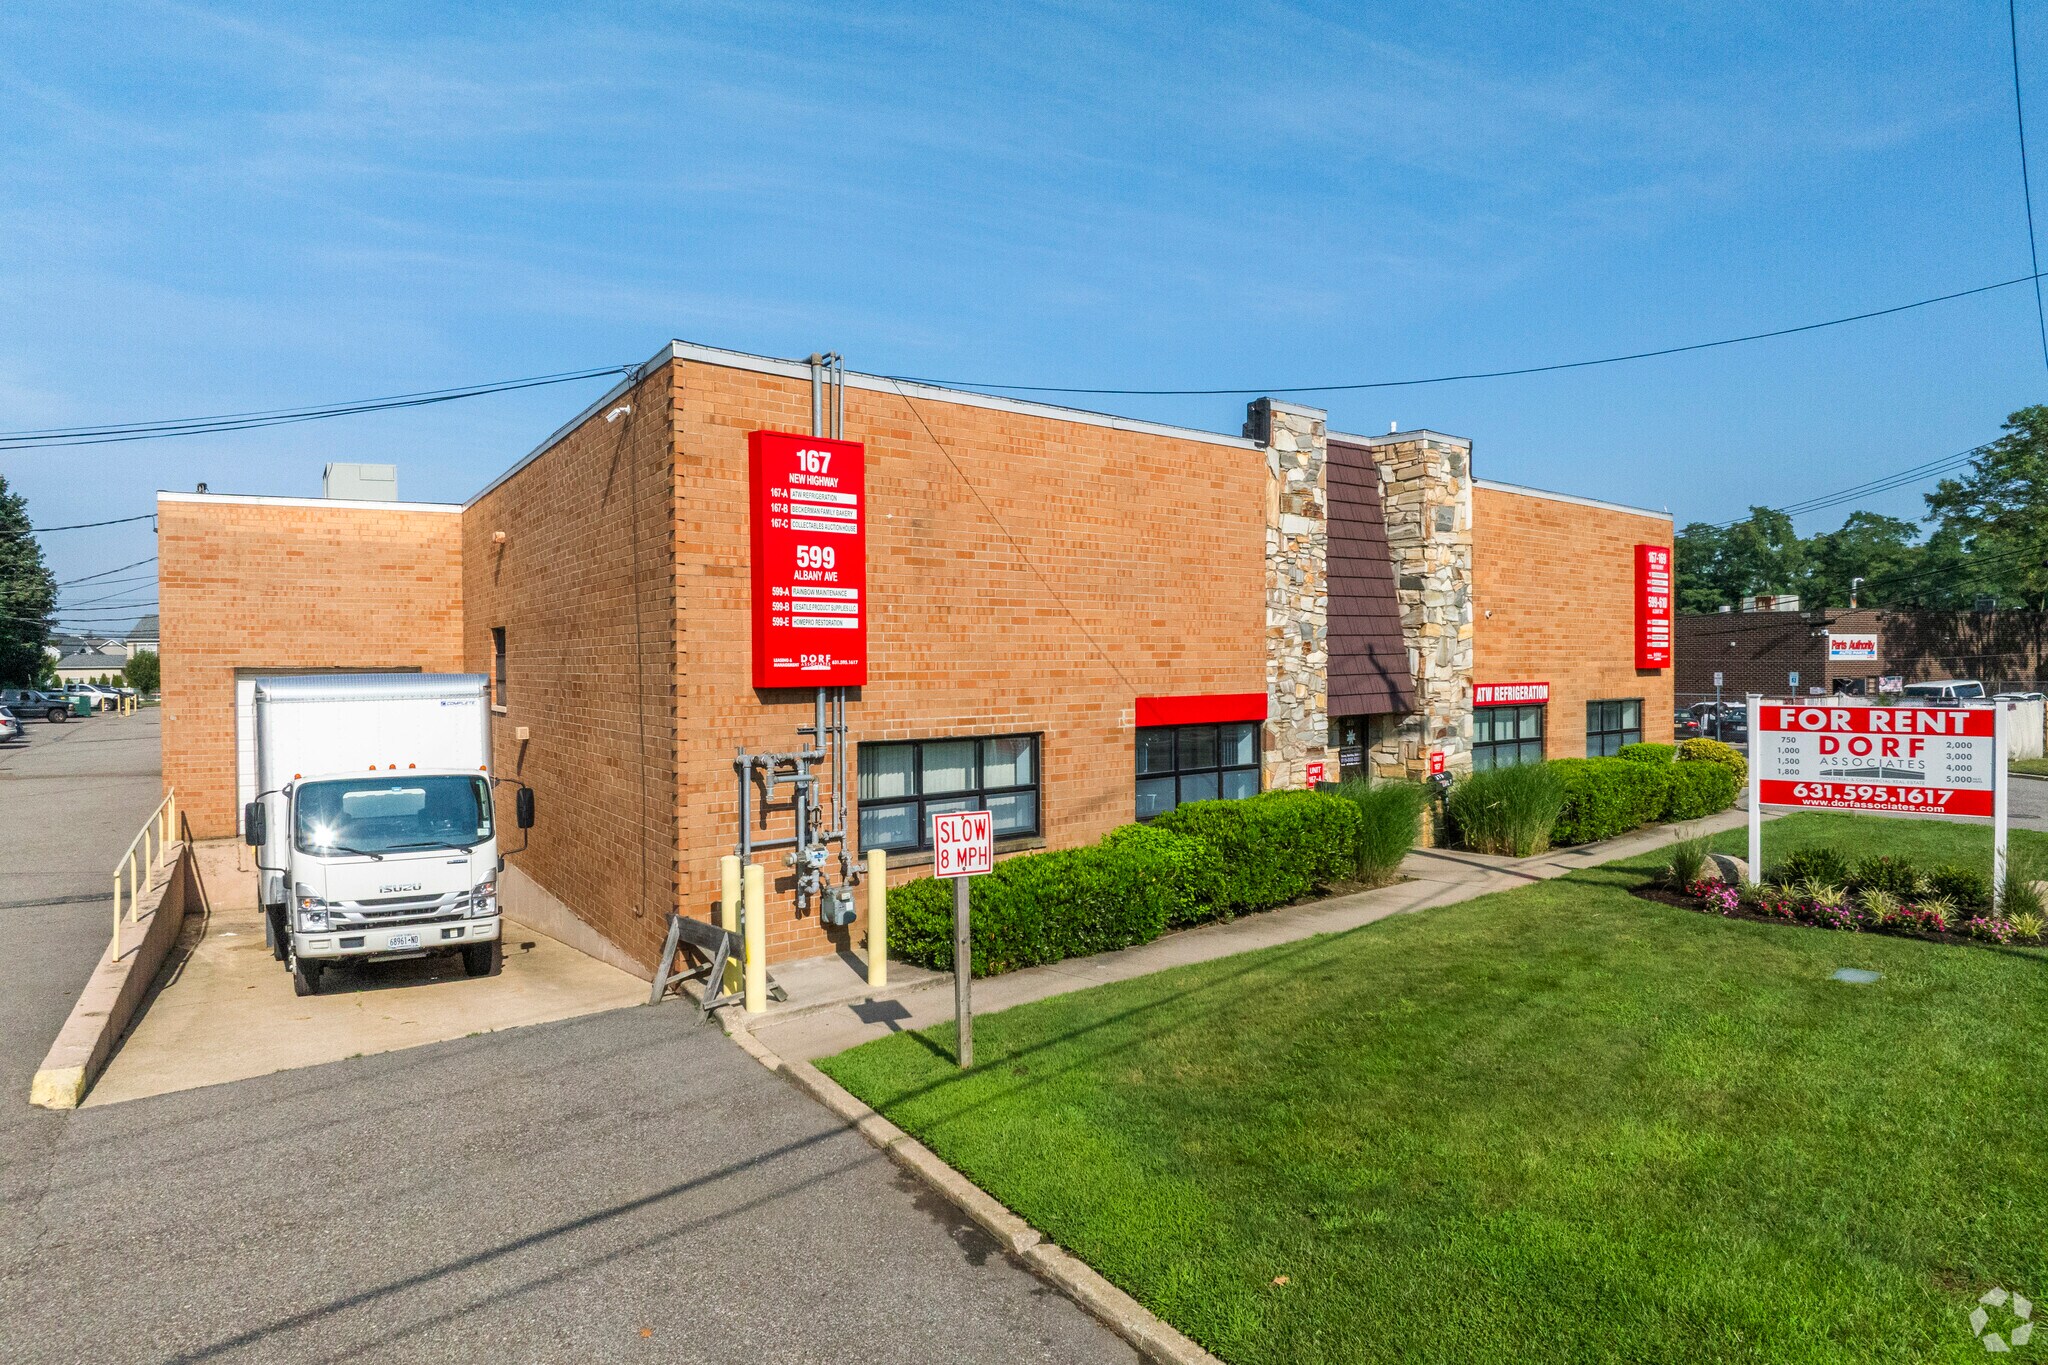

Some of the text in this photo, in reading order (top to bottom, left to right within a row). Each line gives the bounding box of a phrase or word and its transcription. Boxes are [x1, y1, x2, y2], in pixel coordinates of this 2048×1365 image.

[796, 449, 831, 474] 167
[789, 473, 838, 487] NEW HIGHWAY
[770, 487, 788, 498] 167-A
[803, 492, 837, 502] REFRIGERATION
[770, 503, 788, 513] 167-B
[792, 506, 820, 514] BECKERMAN
[820, 508, 836, 516] FAMILY
[770, 518, 788, 528] 167-C
[792, 521, 824, 530] COLLECTABLES
[825, 523, 842, 531] AUCTION
[797, 545, 835, 569] 599
[794, 570, 838, 582] ALBANY AVE
[772, 586, 847, 597] 599-A RAINBOW MAINTENANCE
[772, 602, 790, 611] 599-B
[831, 604, 848, 612] SUPPLIES
[772, 617, 789, 627] 599-E
[815, 618, 843, 626] RESTORATION
[1832, 640, 1875, 652] Parts Authority
[801, 654, 831, 663] DORF
[1476, 685, 1548, 702] ATW REFRIGERATION
[1780, 708, 1970, 734] FOR RENT
[1819, 735, 1925, 758] DORF
[1946, 741, 1972, 749] 2,000
[1819, 757, 1926, 769] ASSOCIATES
[1946, 764, 1972, 772] 4,000
[1310, 766, 1321, 774] UNIT
[1793, 783, 1954, 804] 631.595.1617
[1803, 798, 1945, 813] www.dorfassociates.com
[941, 819, 986, 843] SLOW
[941, 846, 987, 869] 8 MPH
[379, 883, 422, 893] ISUZU
